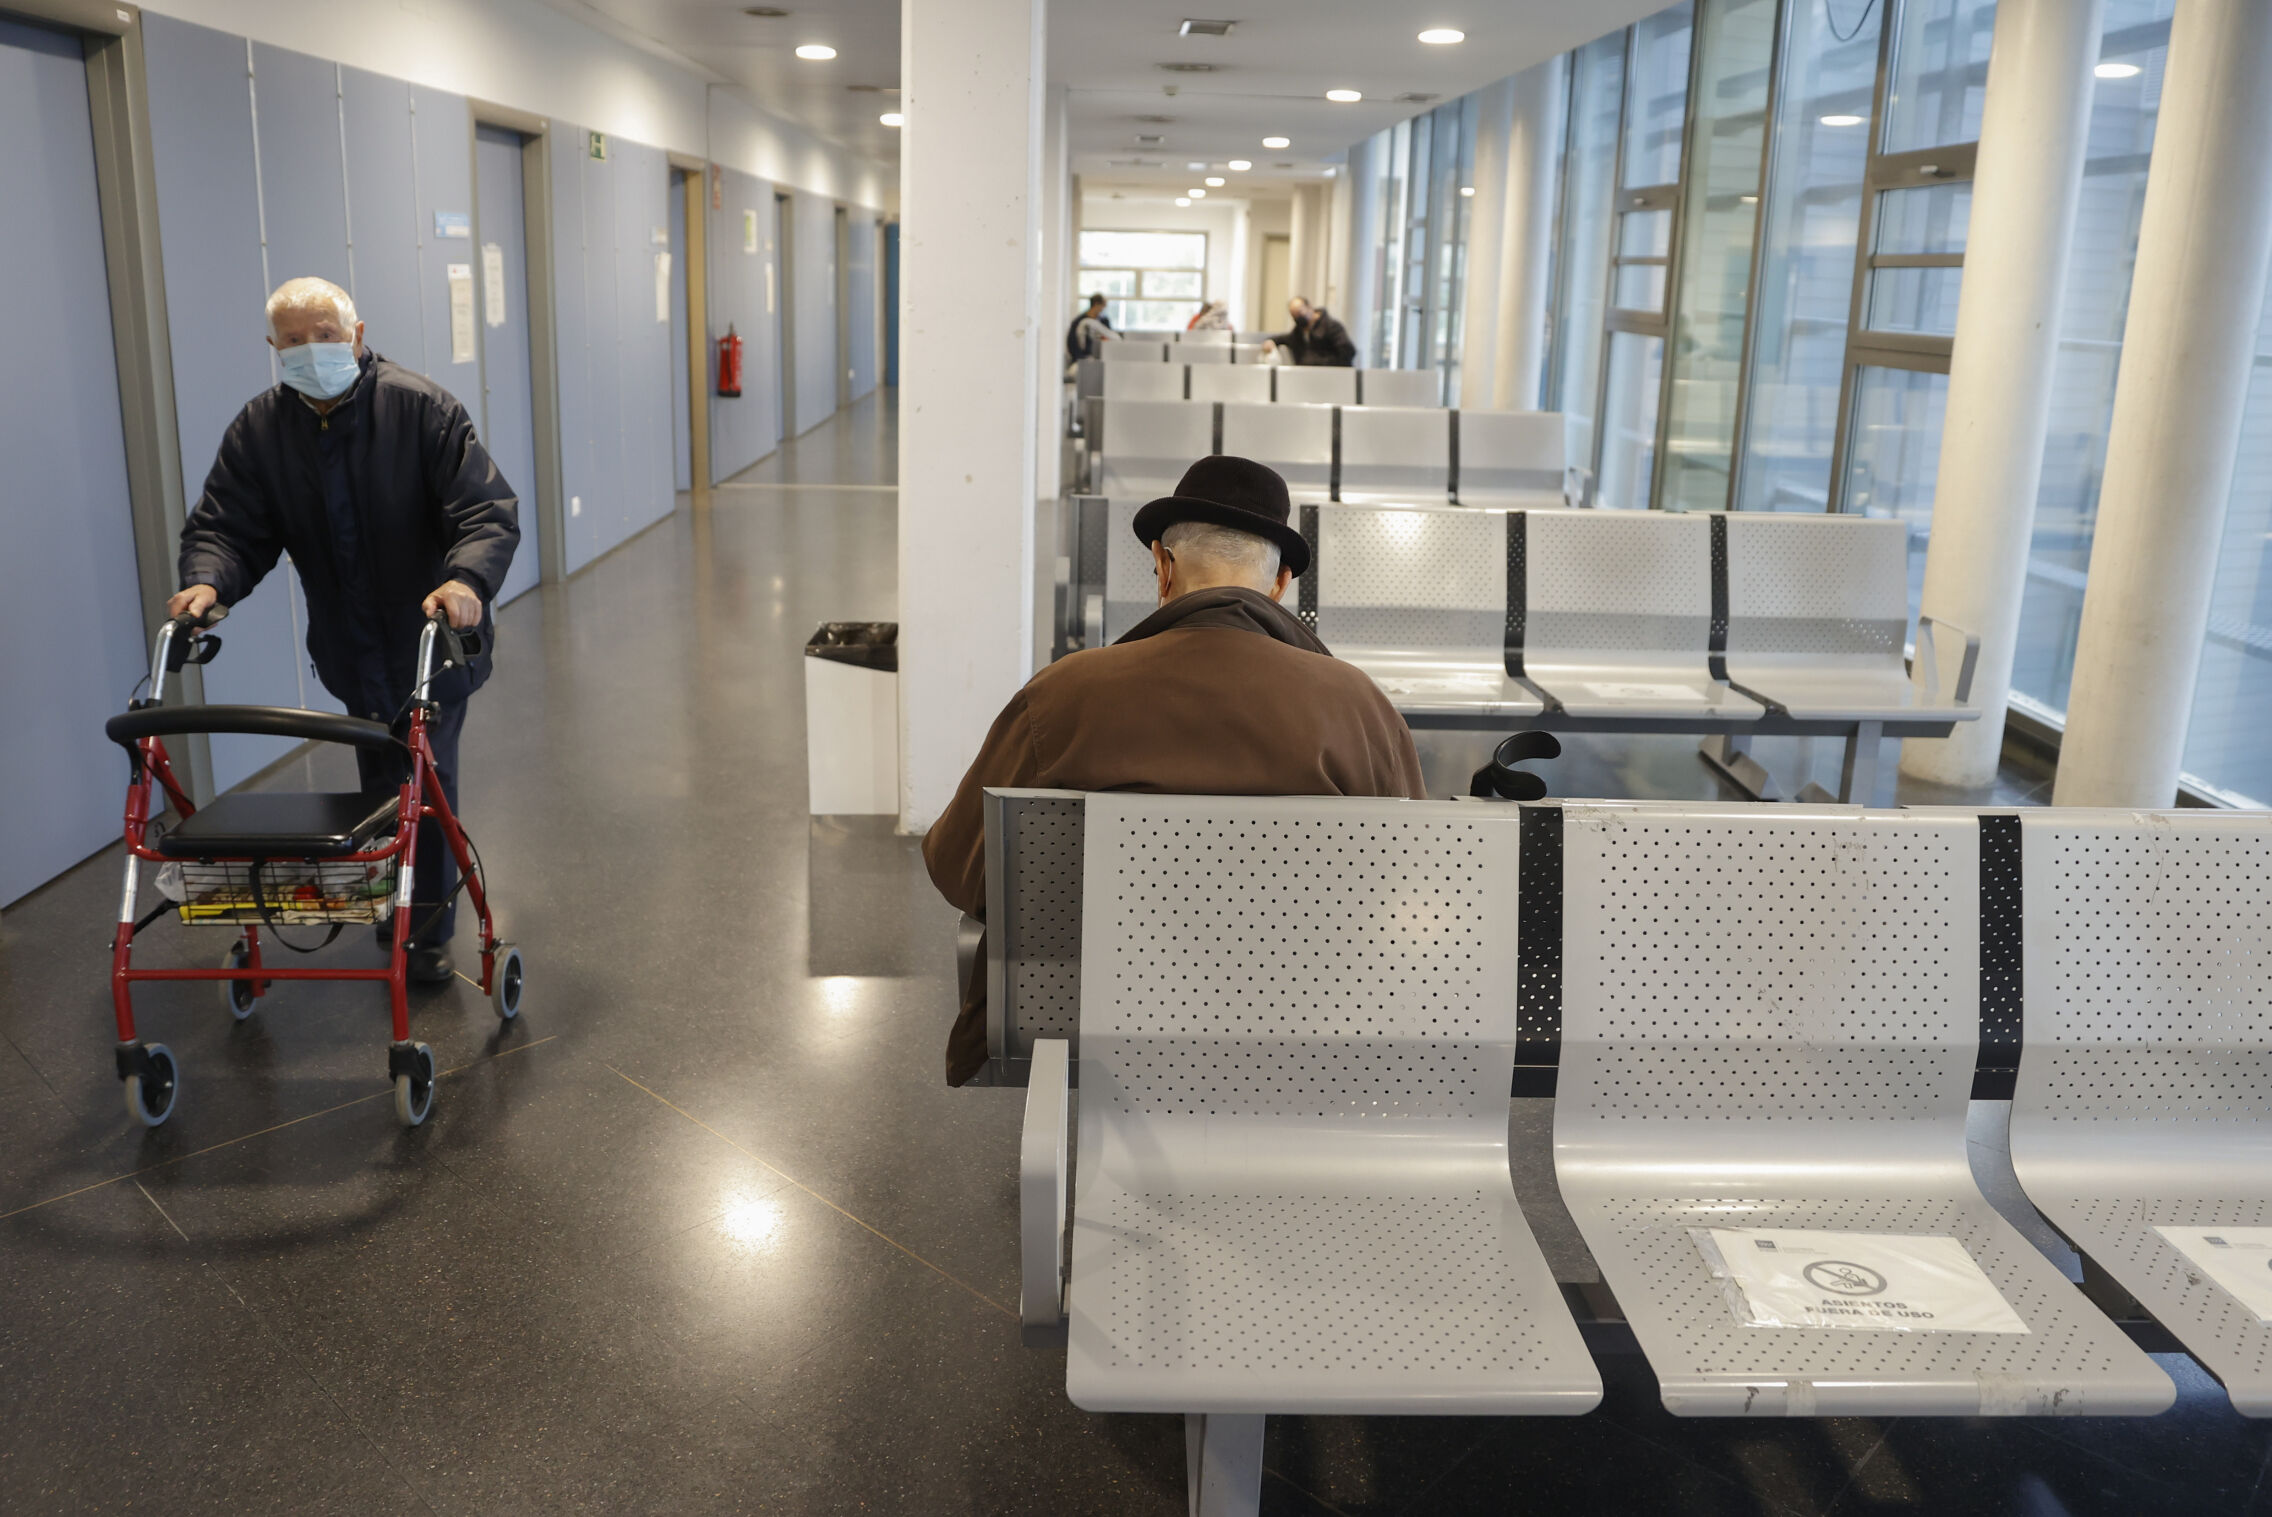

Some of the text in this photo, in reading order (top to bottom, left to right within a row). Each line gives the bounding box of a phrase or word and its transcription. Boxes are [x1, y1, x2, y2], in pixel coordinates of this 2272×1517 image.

[1822, 1299, 1908, 1309] ASIENTOS
[1804, 1306, 1935, 1319] FUERA DE USO
